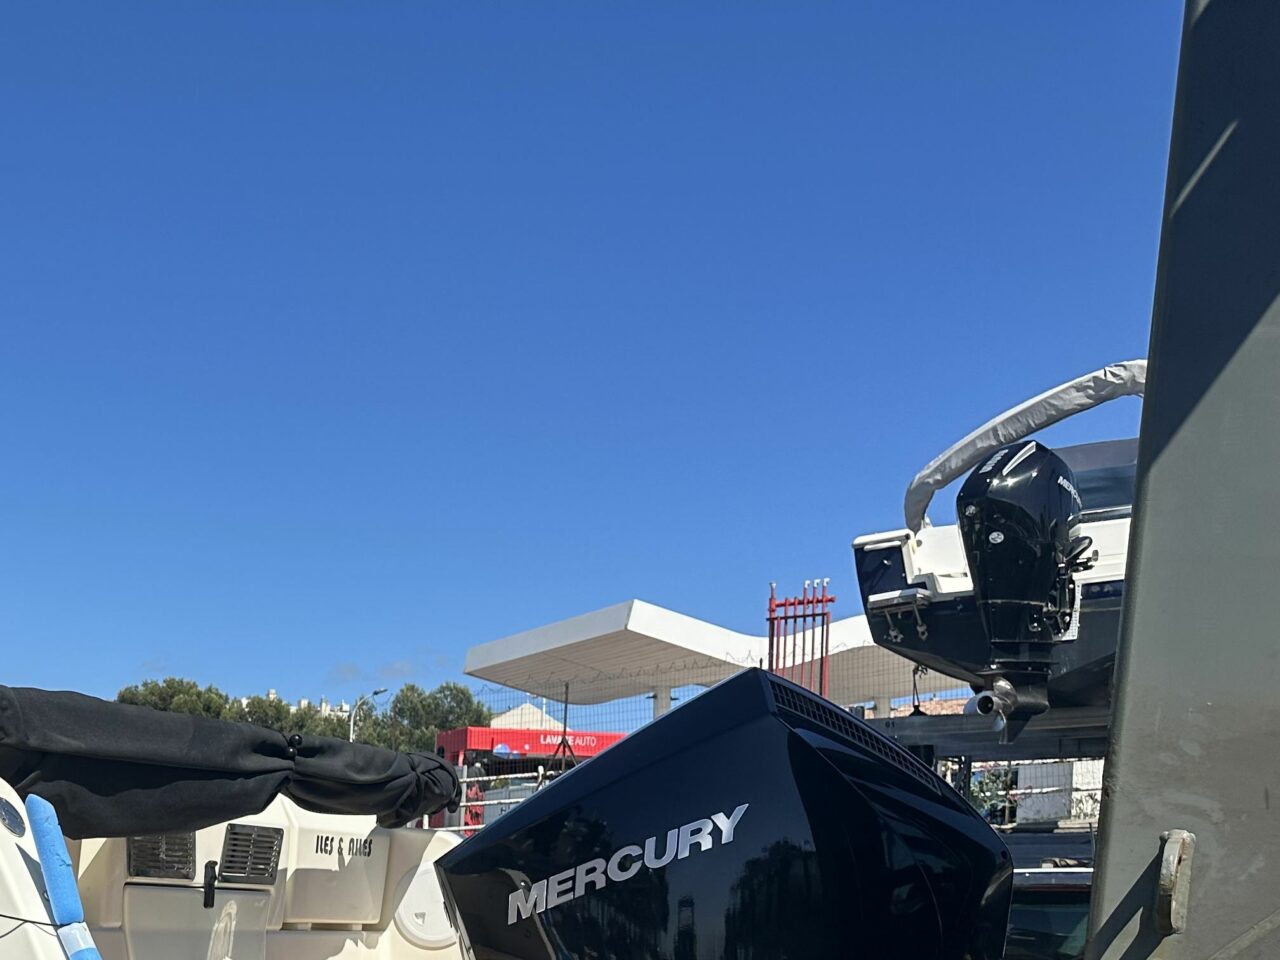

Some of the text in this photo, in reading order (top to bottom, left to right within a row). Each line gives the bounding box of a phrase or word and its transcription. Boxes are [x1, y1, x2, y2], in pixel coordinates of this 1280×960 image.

[540, 734, 597, 747] LAVAE AUTO
[507, 803, 750, 926] MERCURY
